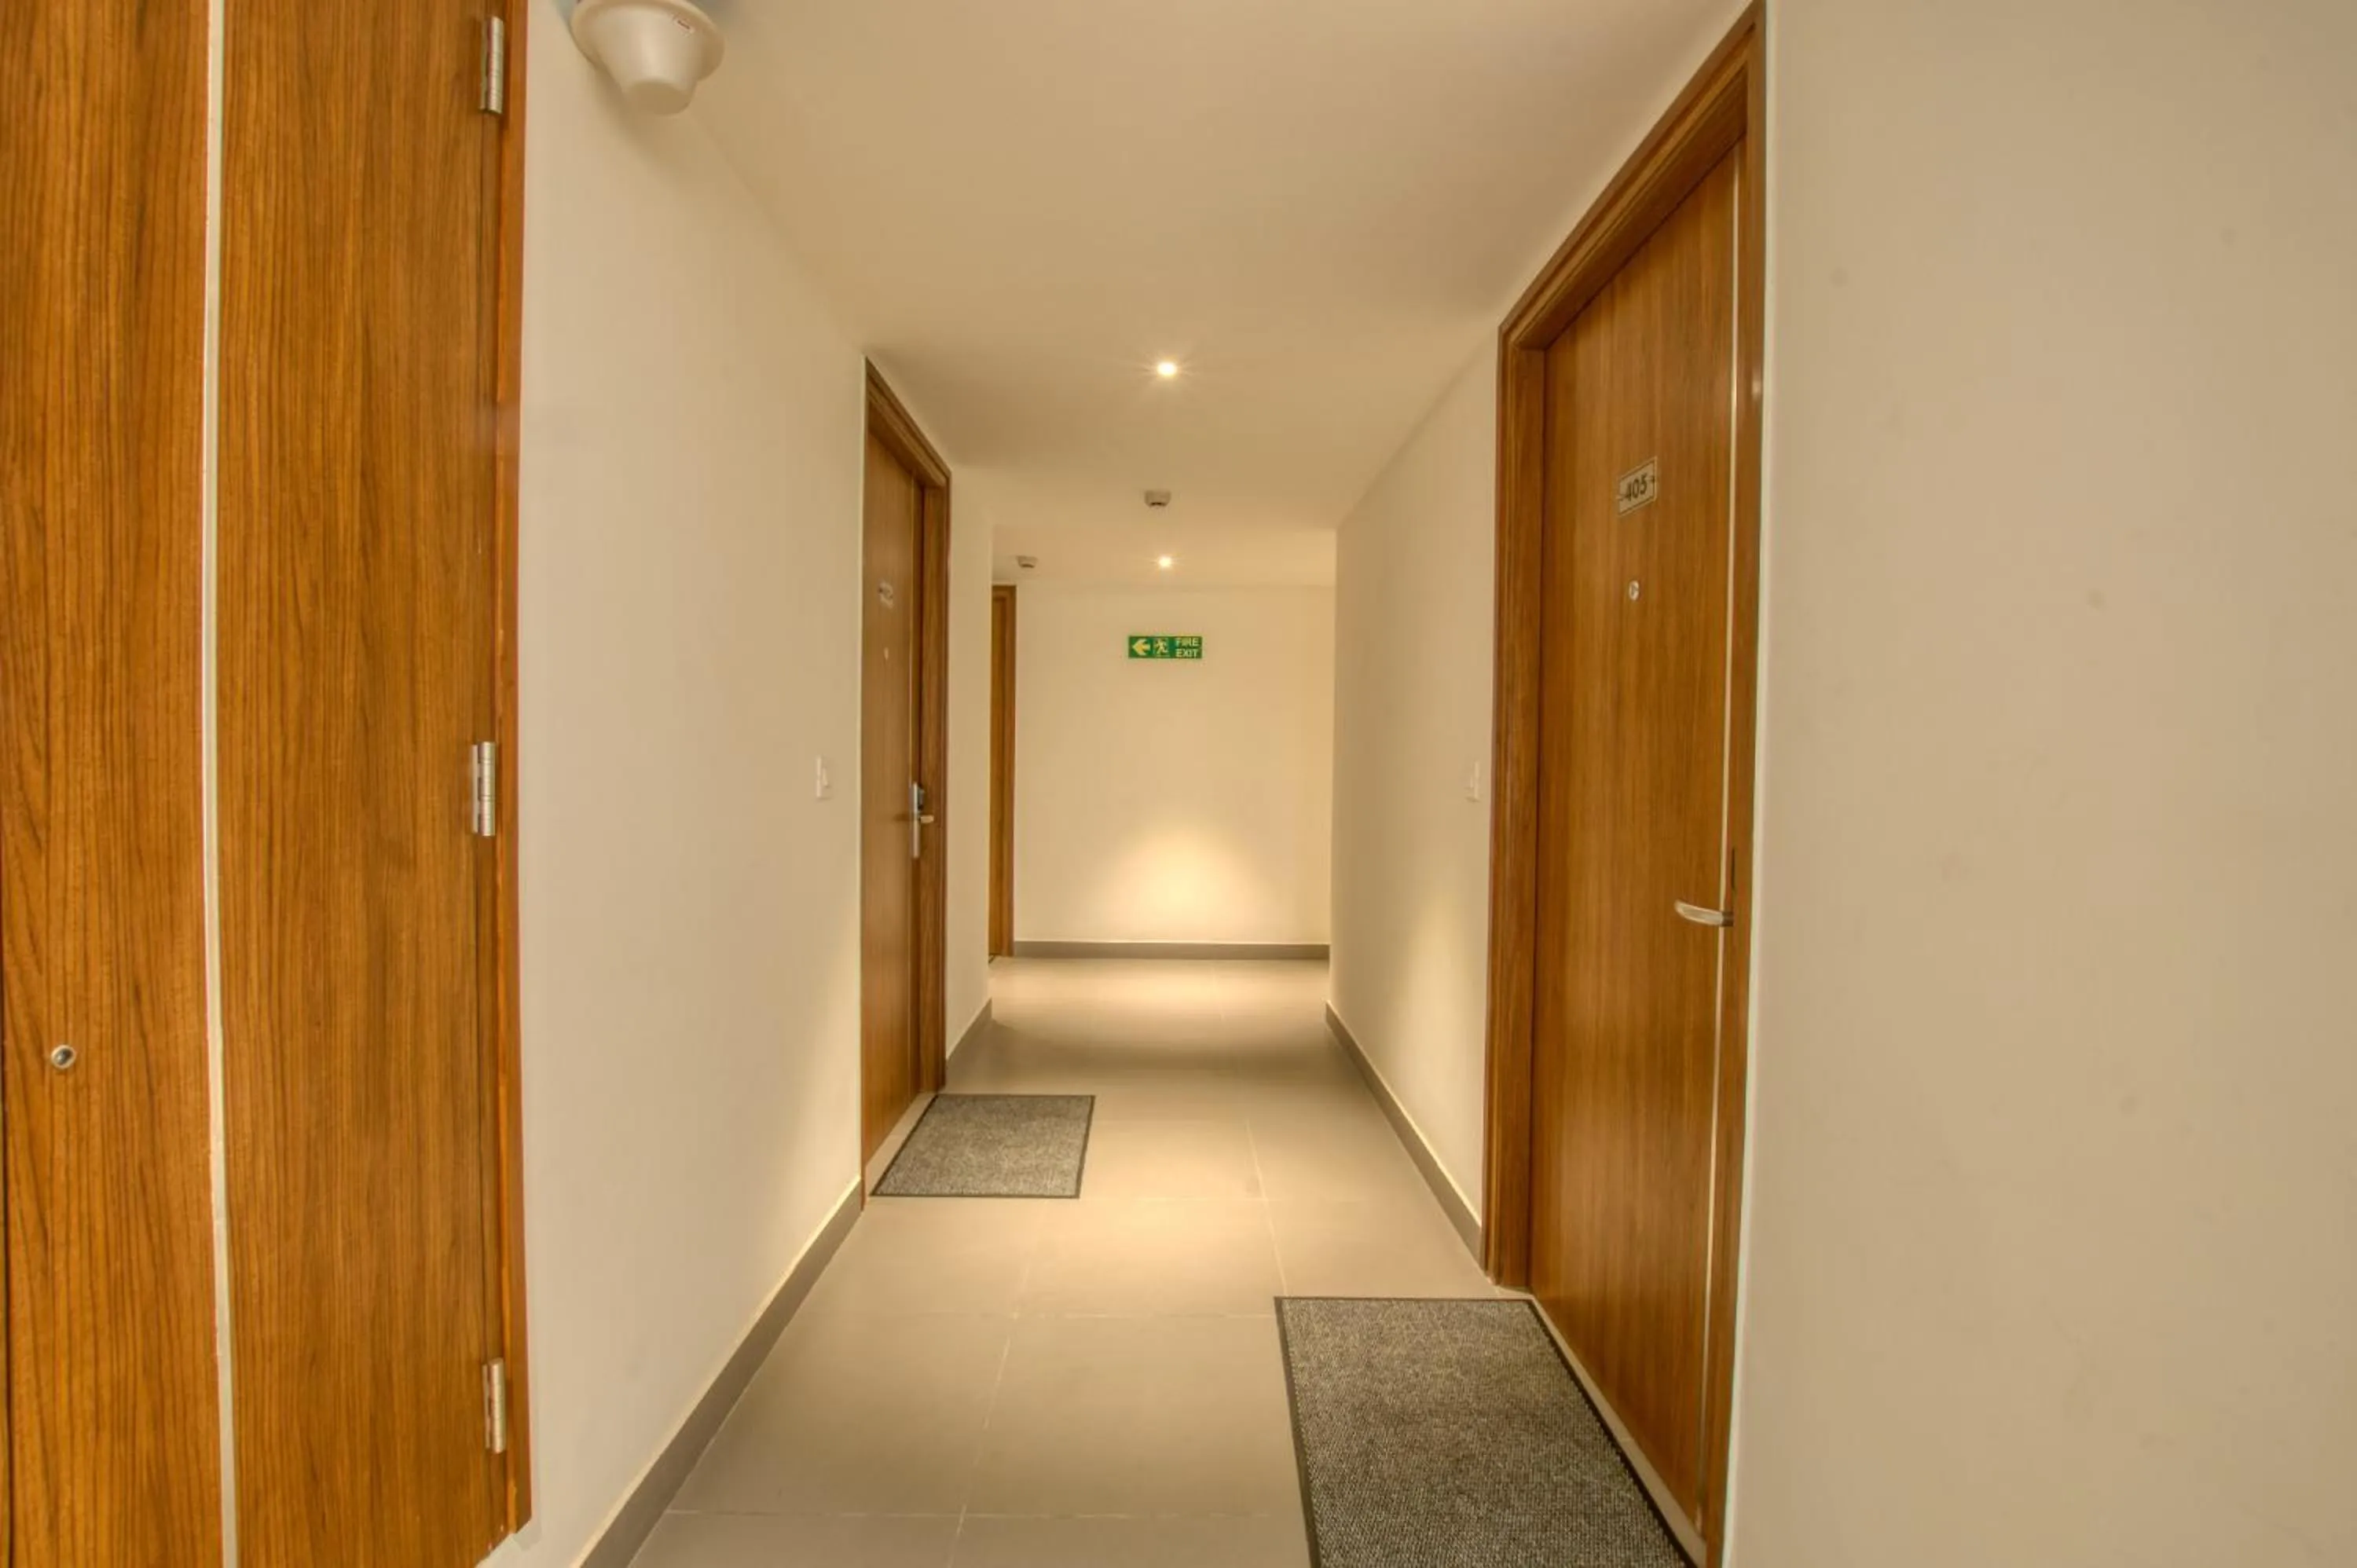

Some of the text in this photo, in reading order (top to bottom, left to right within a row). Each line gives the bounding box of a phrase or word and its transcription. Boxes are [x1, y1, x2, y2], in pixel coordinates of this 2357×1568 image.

[1625, 473, 1648, 501] 405
[1175, 637, 1199, 647] FIRE
[1175, 648, 1198, 658] EXIT
